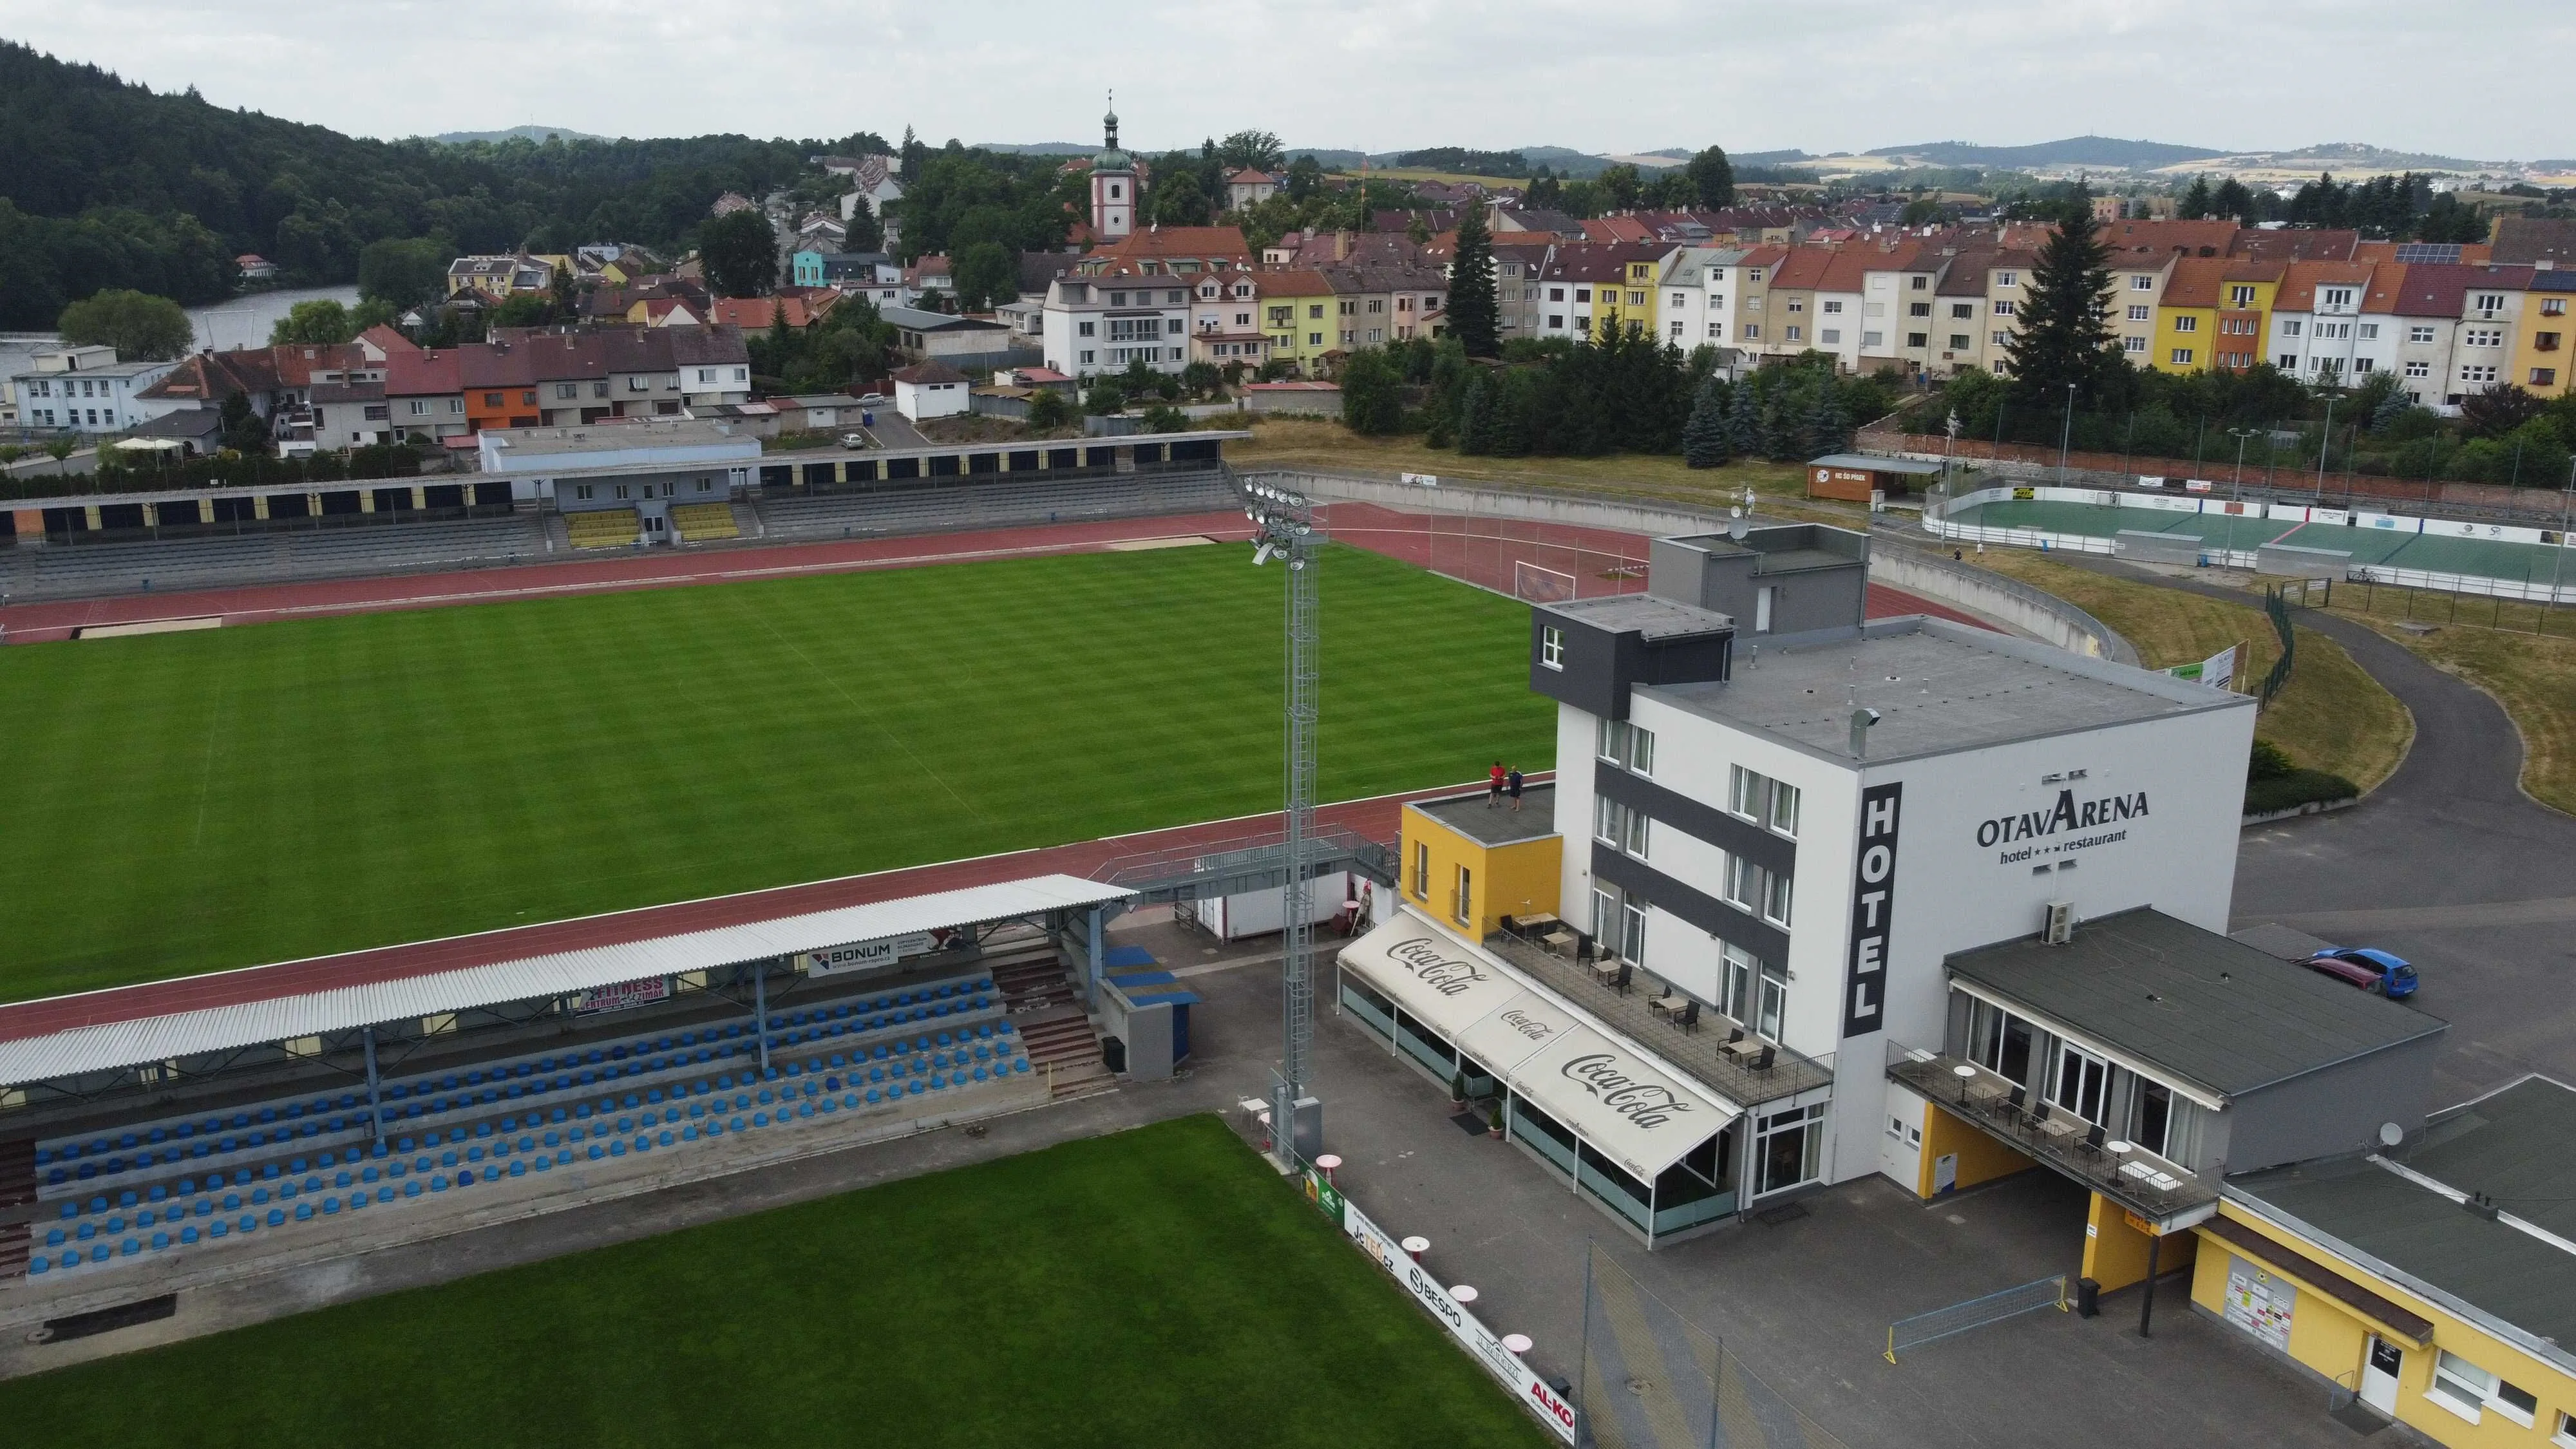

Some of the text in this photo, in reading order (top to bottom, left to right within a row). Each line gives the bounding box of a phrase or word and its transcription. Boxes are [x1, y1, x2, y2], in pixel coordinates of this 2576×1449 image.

[1976, 789, 2150, 848] OTAVARENA
[2000, 829, 2128, 865] hotel restaurant
[1854, 797, 1895, 1019] HOTEL
[831, 943, 891, 963] BONUM
[1386, 938, 1490, 996] Coca-Cola
[597, 976, 664, 998] FITNESS
[1501, 1010, 1554, 1041] Coca-Cola
[1561, 1054, 1696, 1129] Coca-Cola
[1425, 1283, 1461, 1328] BESPO
[1531, 1381, 1573, 1428] AL-KO
